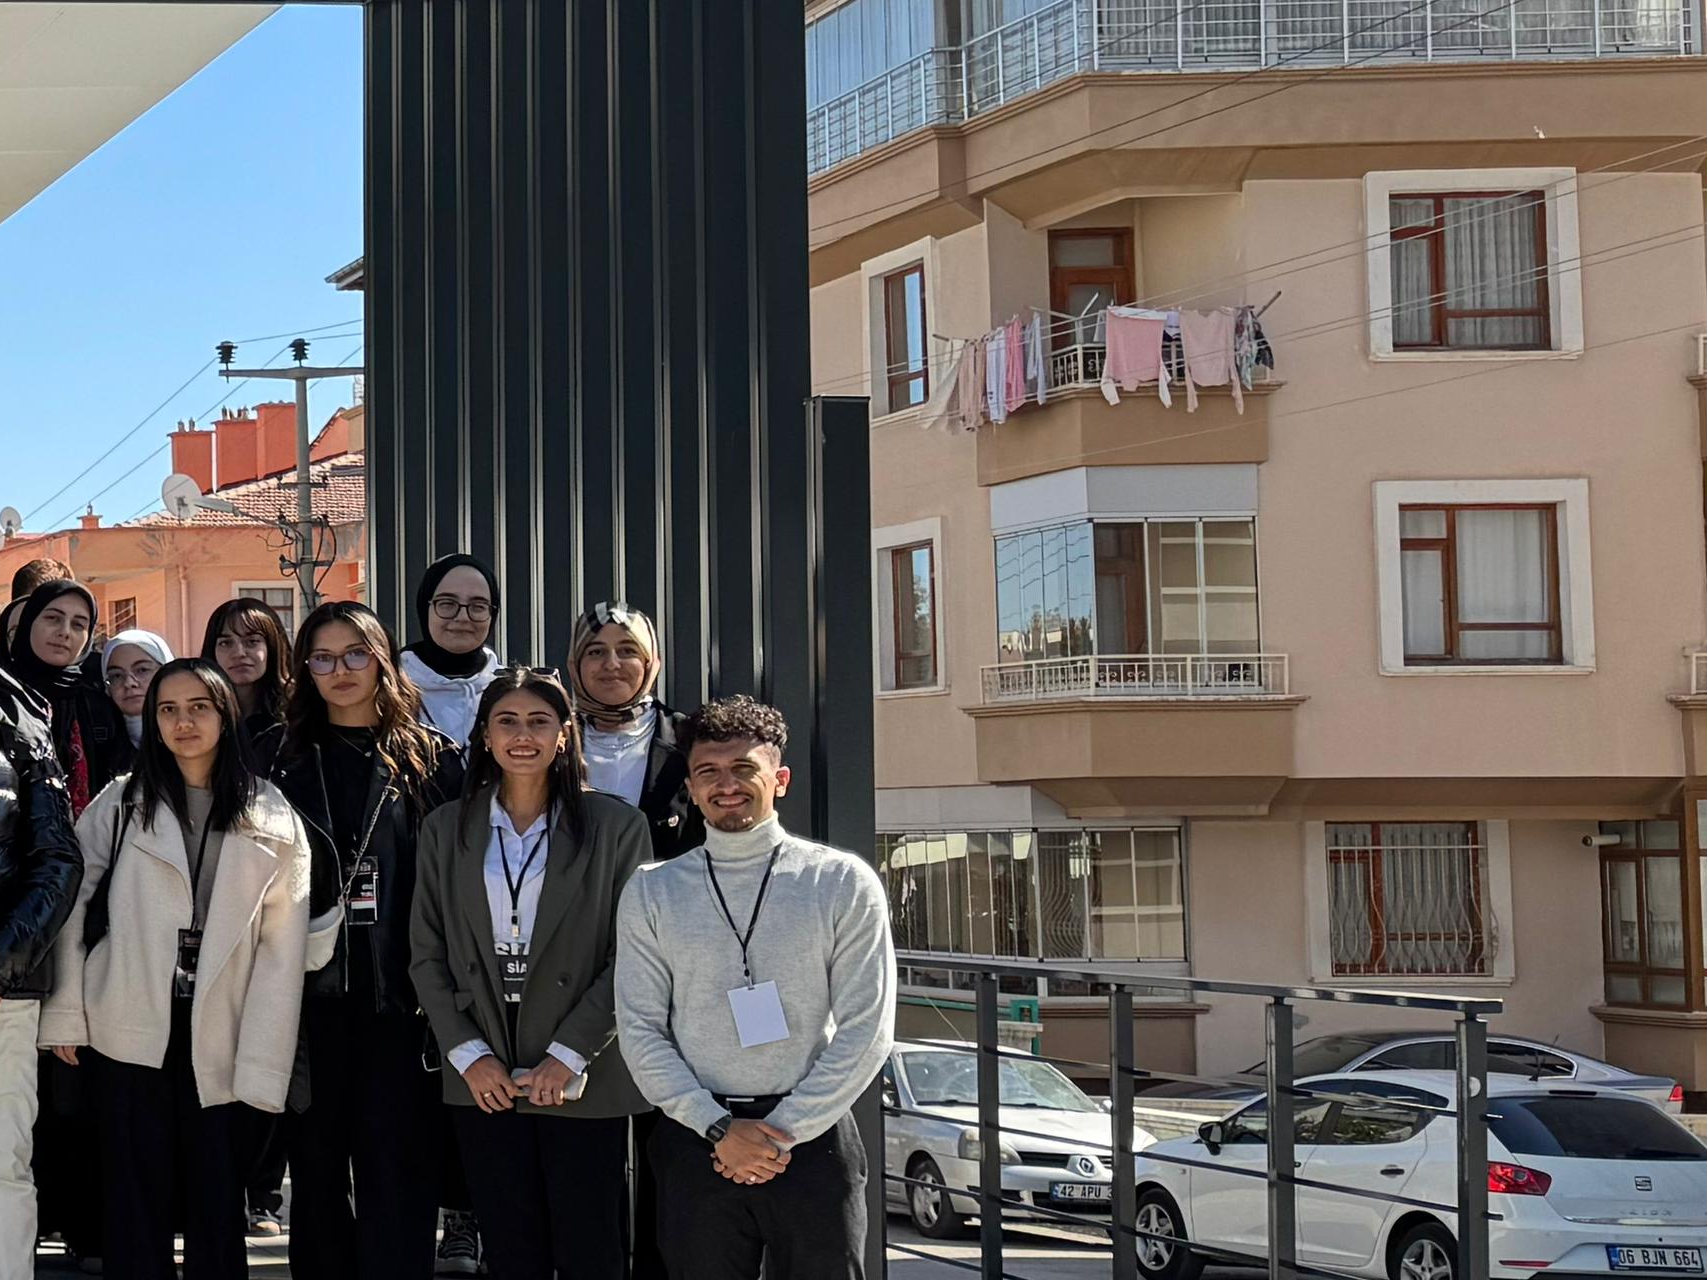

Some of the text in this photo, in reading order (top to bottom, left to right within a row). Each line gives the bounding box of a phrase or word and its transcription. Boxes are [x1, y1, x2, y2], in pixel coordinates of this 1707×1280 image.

[1060, 1185, 1074, 1197] 42
[1081, 1185, 1101, 1198] APU
[1619, 1249, 1699, 1266] 06 BJN 664
